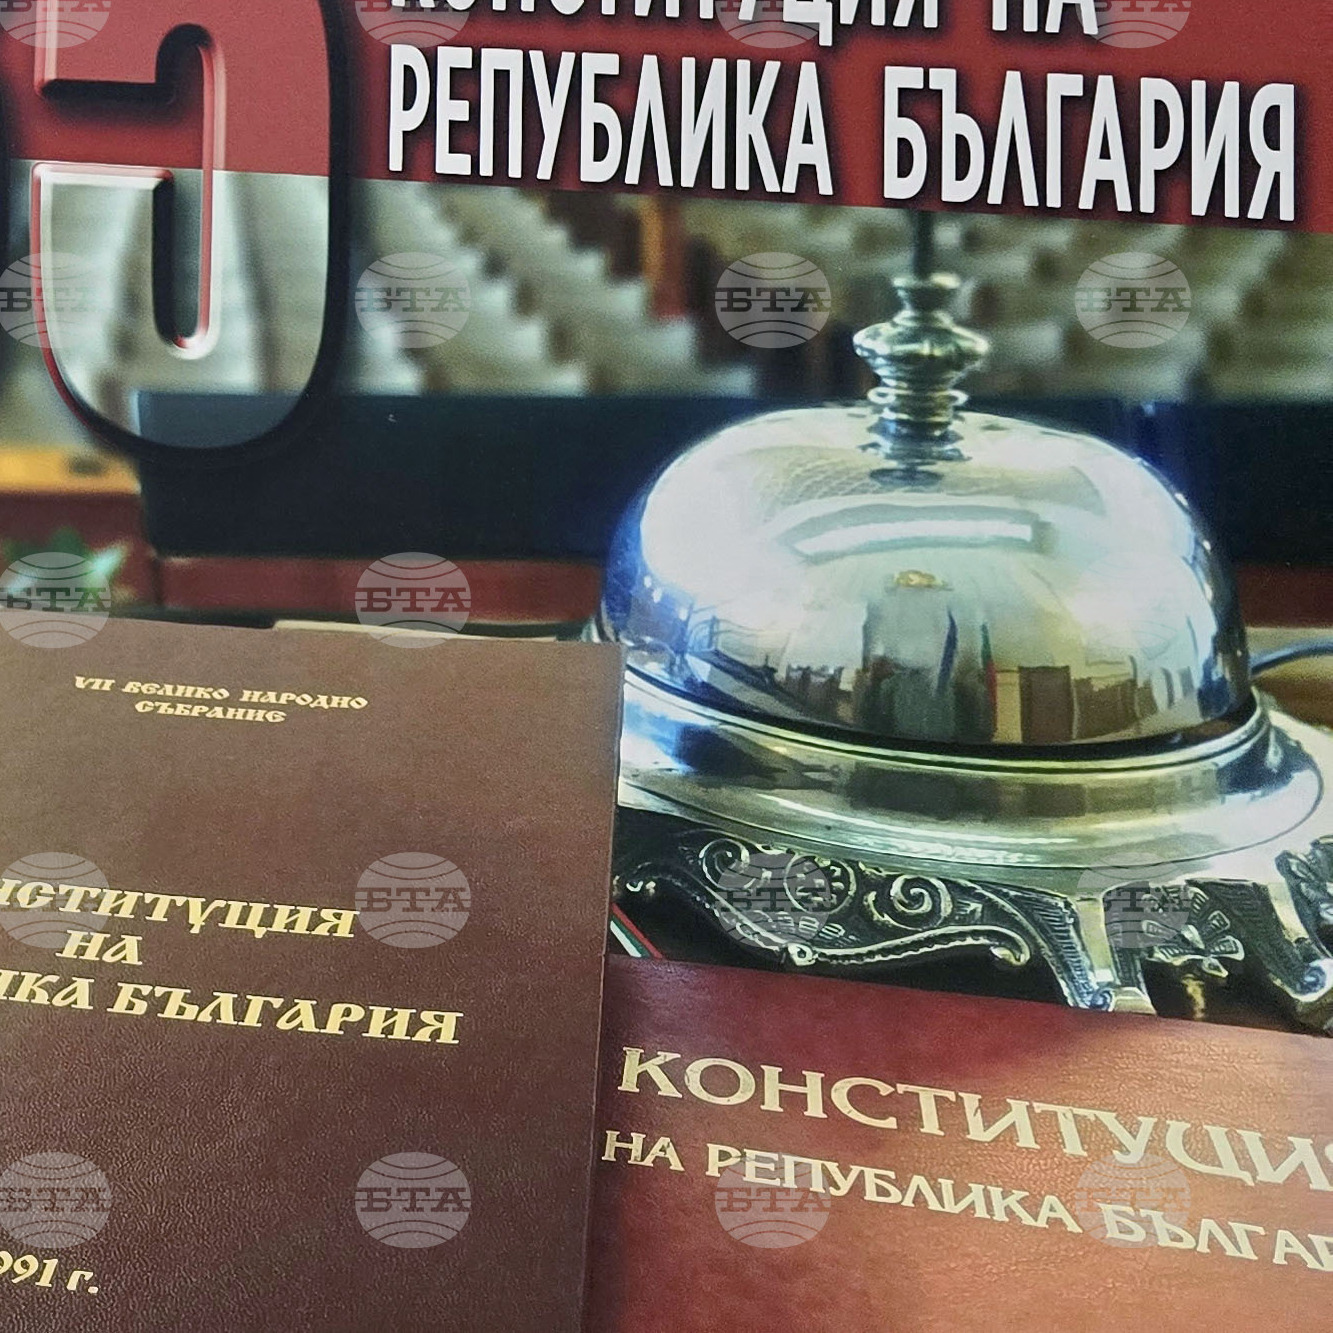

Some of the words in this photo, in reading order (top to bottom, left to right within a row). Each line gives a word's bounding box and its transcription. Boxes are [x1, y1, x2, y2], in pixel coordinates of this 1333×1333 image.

[388, 47, 833, 197] РЕПУБЛИКА
[883, 67, 1295, 222] БЪЛГАРИЯ
[122, 681, 229, 700] ВЕЛИКО
[240, 689, 368, 709] НАРОДНО
[135, 700, 287, 723] СЪБРАНИЕ
[56, 929, 143, 965] НА
[106, 982, 464, 1044] БЪЛГАРИЯ
[617, 1046, 1333, 1191] КОНСТИТУЦИ
[601, 1131, 685, 1171] НА
[706, 1143, 1083, 1233] РЕПУБЛИКА
[67, 1270, 99, 1294] г.
